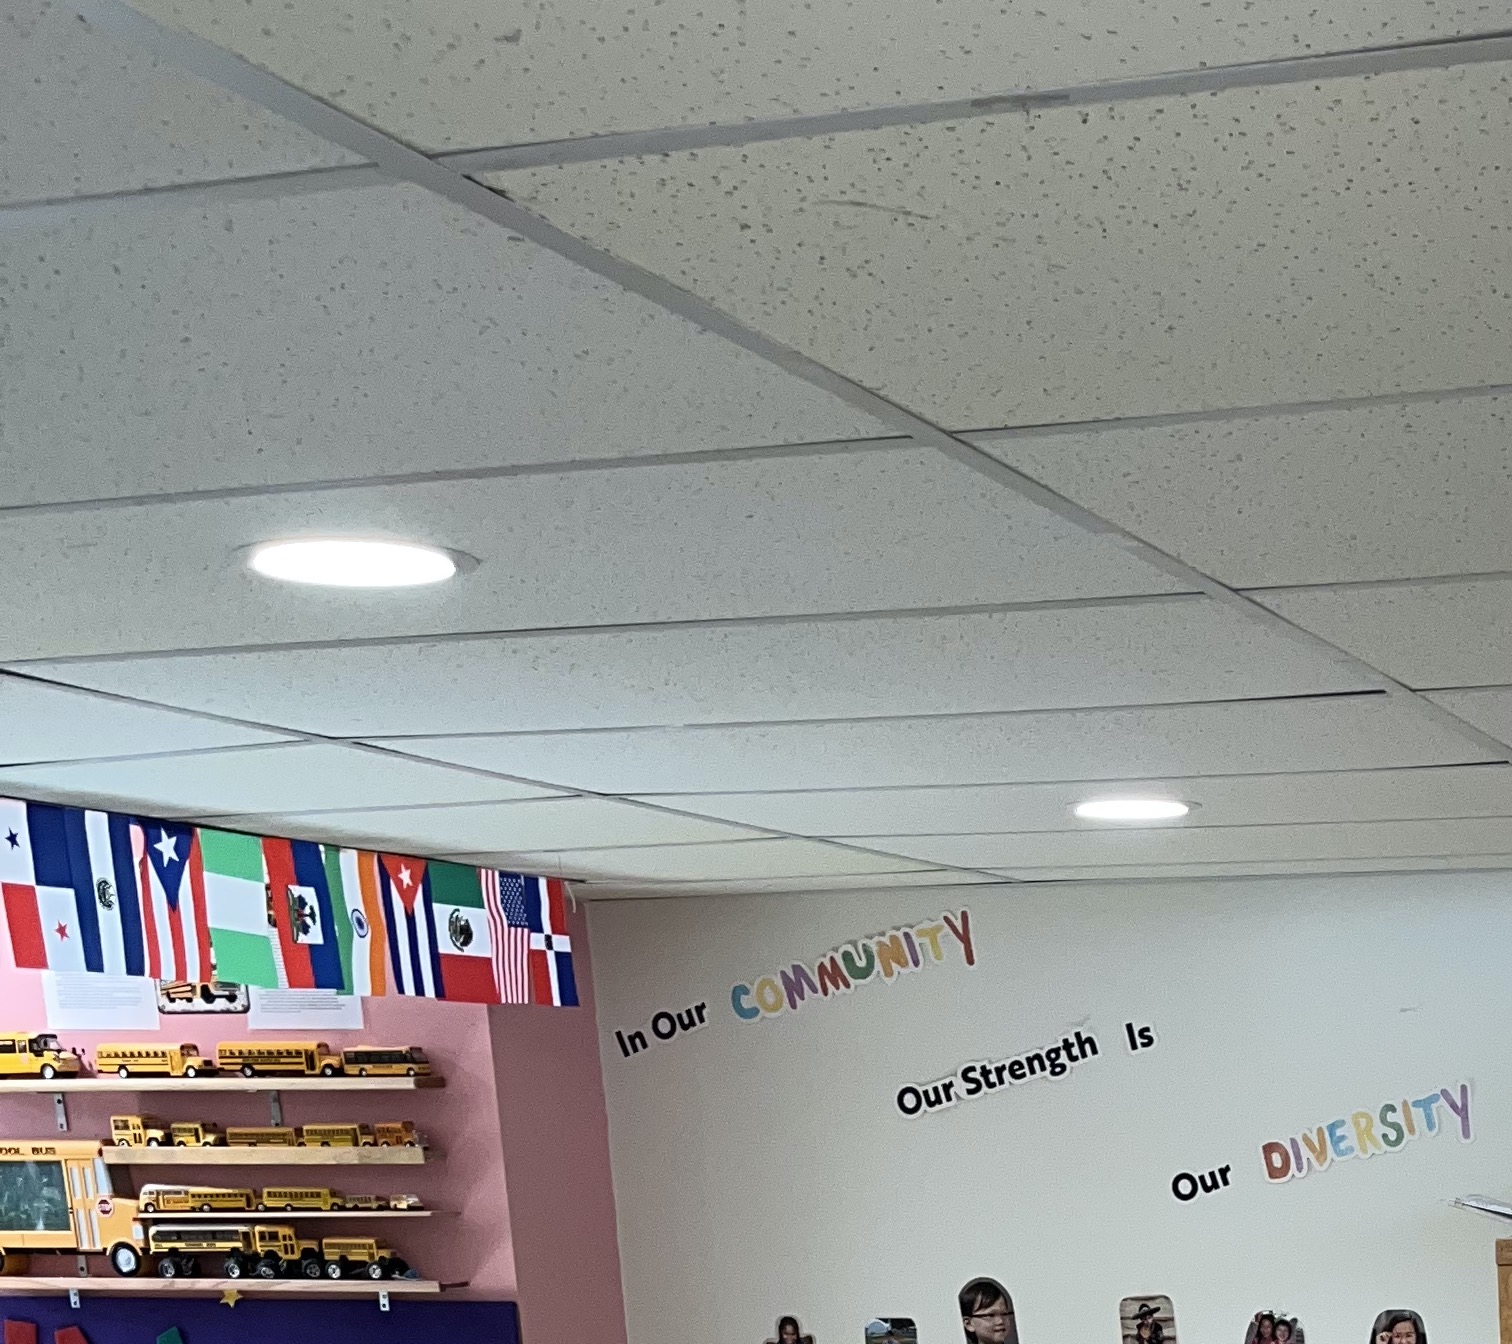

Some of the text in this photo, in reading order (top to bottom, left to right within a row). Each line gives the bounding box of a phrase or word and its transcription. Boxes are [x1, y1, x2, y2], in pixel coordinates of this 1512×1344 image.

[615, 910, 975, 1058] In Our COMMUNITY
[896, 1022, 1155, 1115] Our Strength Is
[1171, 1084, 1471, 1202] Our DIVERSITY
